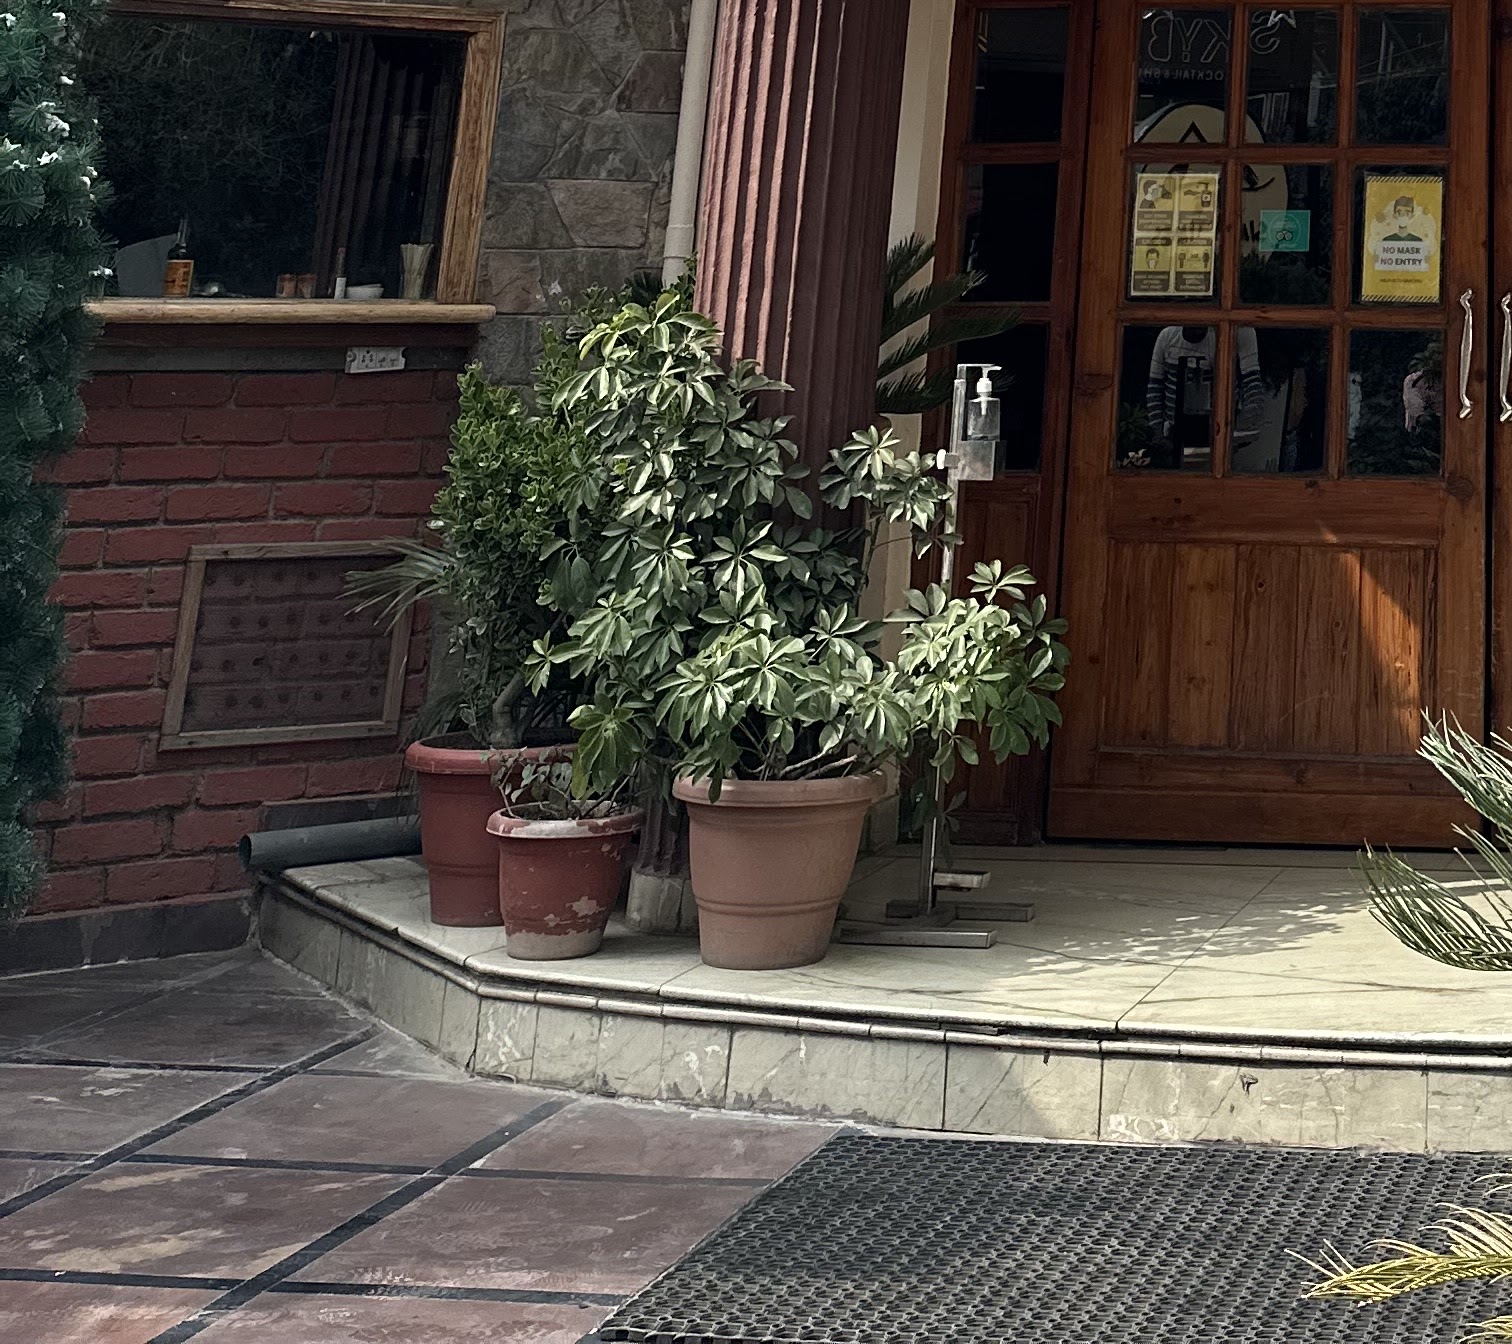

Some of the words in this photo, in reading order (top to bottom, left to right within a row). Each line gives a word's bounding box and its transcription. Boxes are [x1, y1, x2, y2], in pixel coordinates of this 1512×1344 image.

[1382, 246, 1396, 255] NO
[1397, 246, 1422, 255] MASK
[1380, 258, 1394, 266] NO
[1395, 257, 1423, 266] ENTRY
